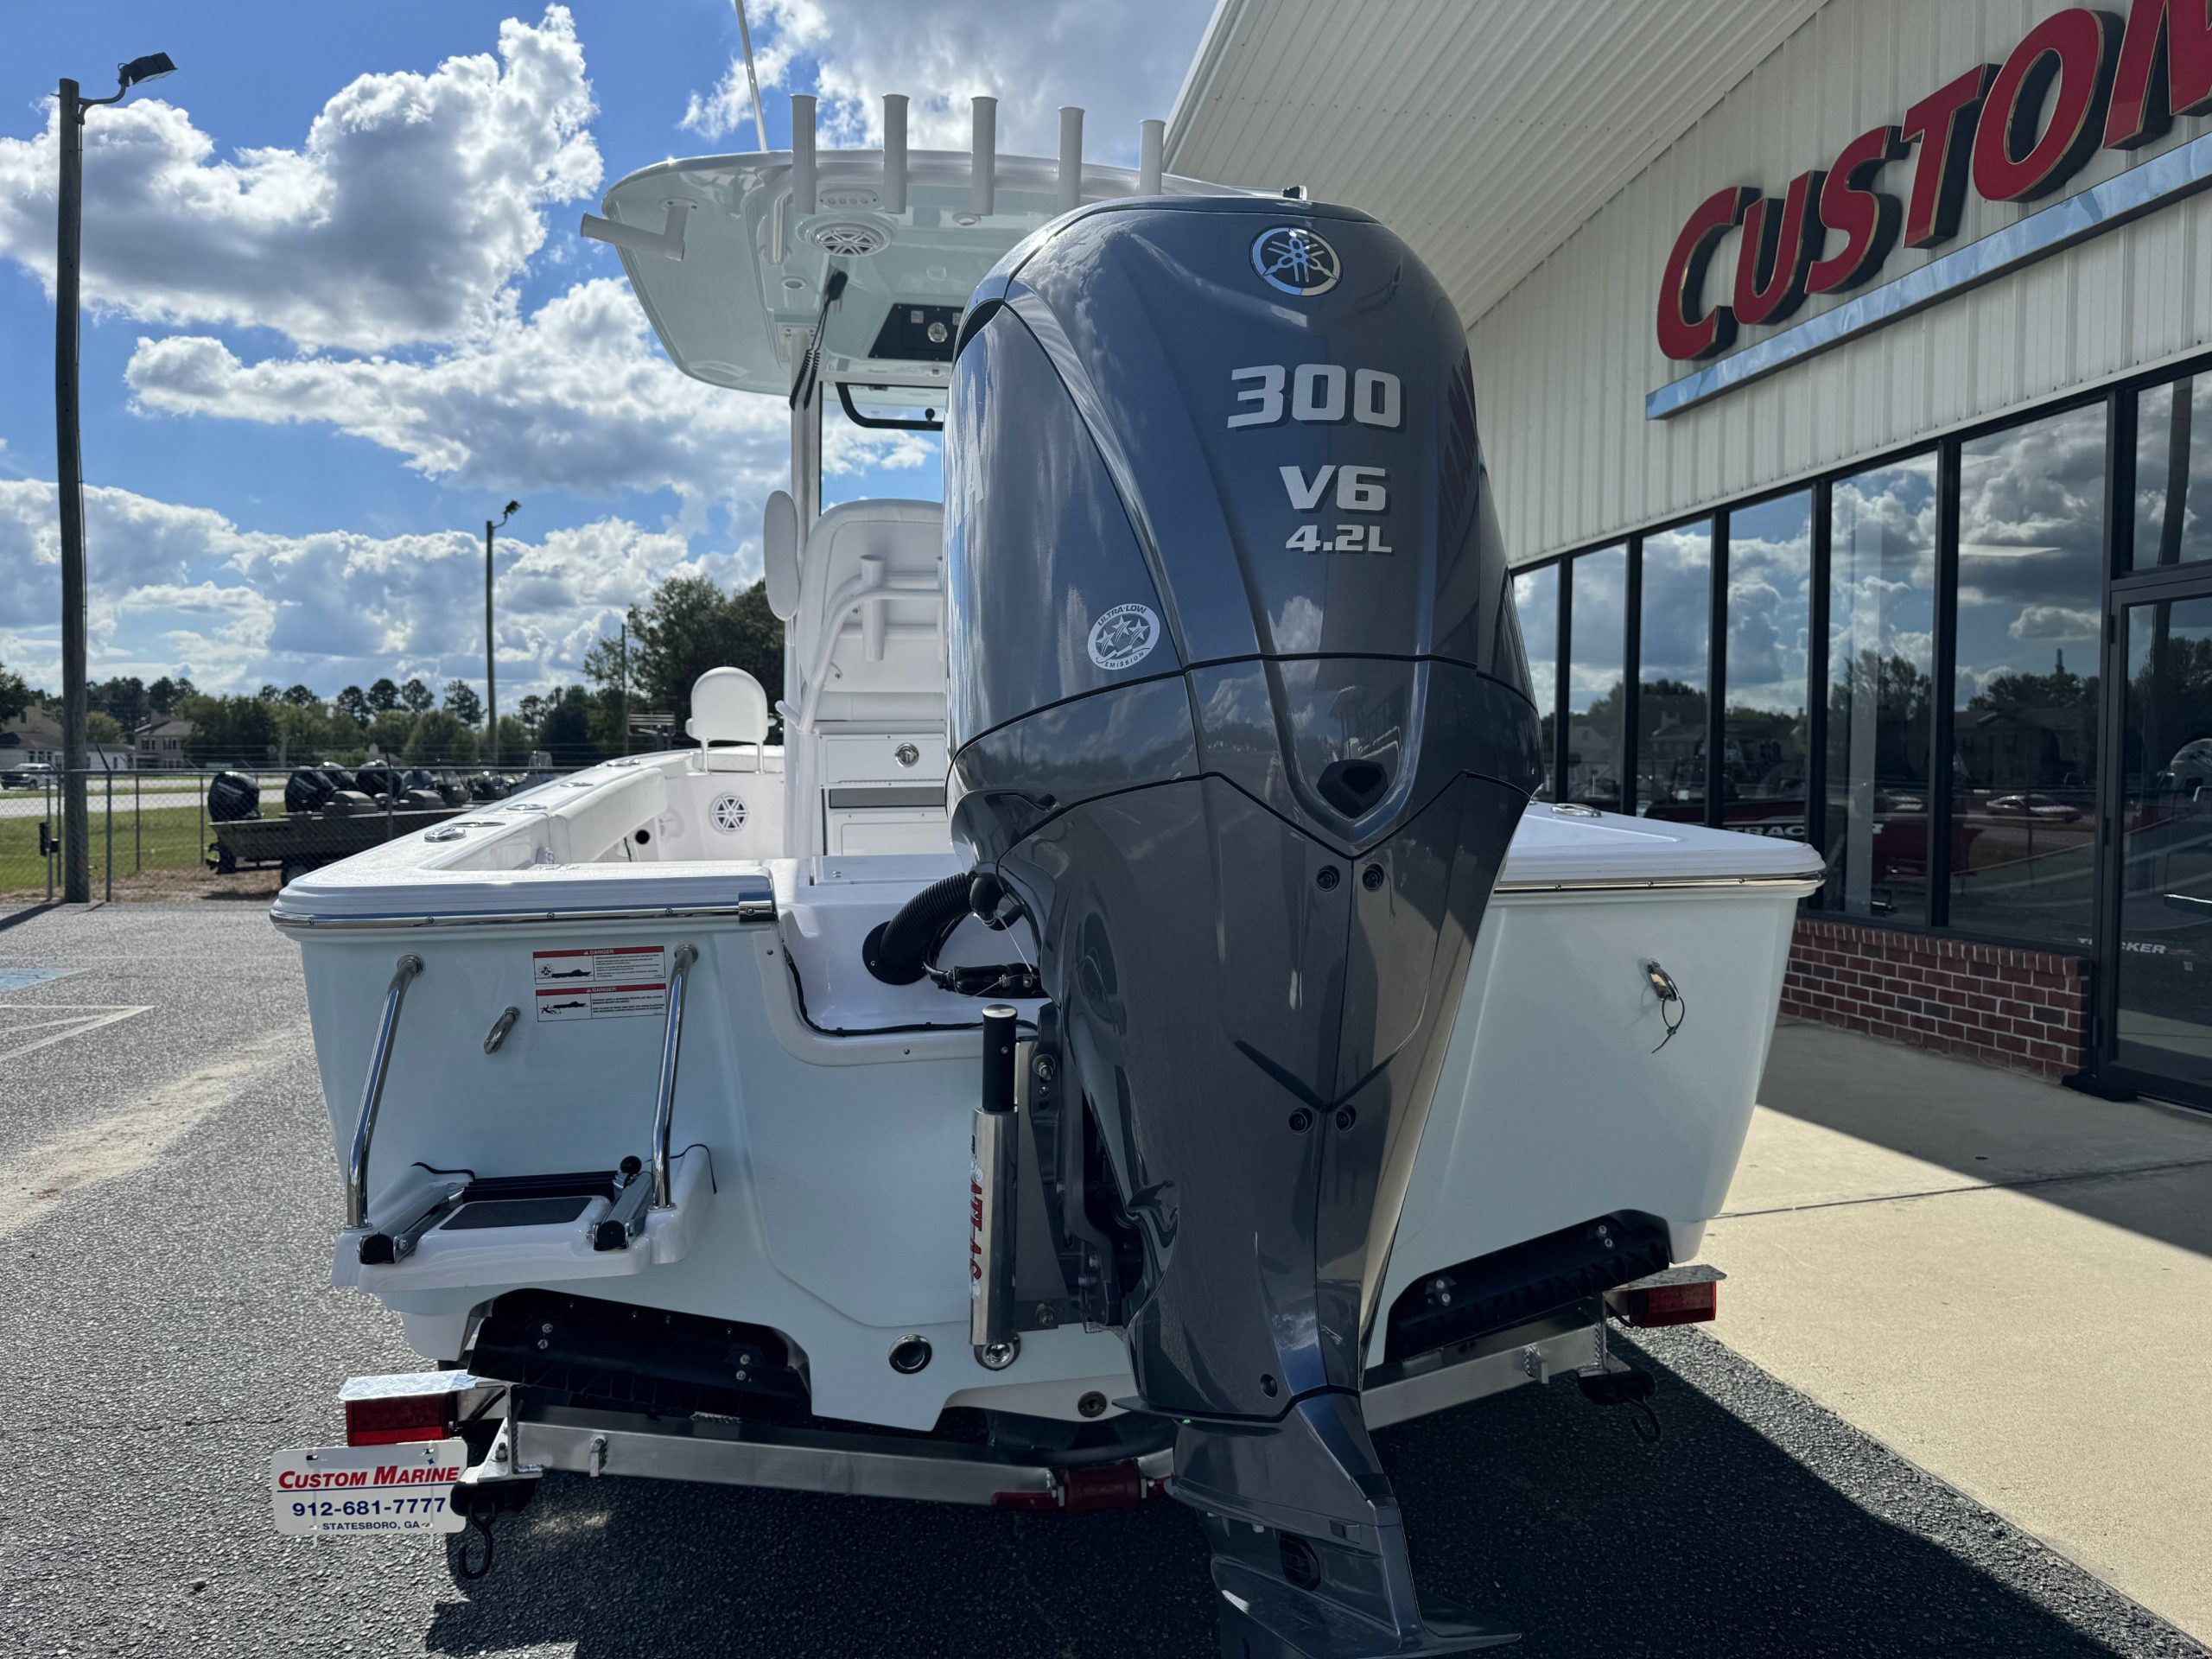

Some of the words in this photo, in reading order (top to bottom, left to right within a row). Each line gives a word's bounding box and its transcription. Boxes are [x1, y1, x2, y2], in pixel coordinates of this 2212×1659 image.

[1227, 364, 1402, 429] 300
[1279, 464, 1387, 512] V6
[1286, 524, 1392, 553] 4.2L
[1105, 652, 1144, 668] EMISSION
[278, 1471, 367, 1490] CUSTOM
[373, 1465, 460, 1485] MARINE
[292, 1497, 446, 1517] 912-681-7777
[322, 1522, 400, 1531] STATESBORO,
